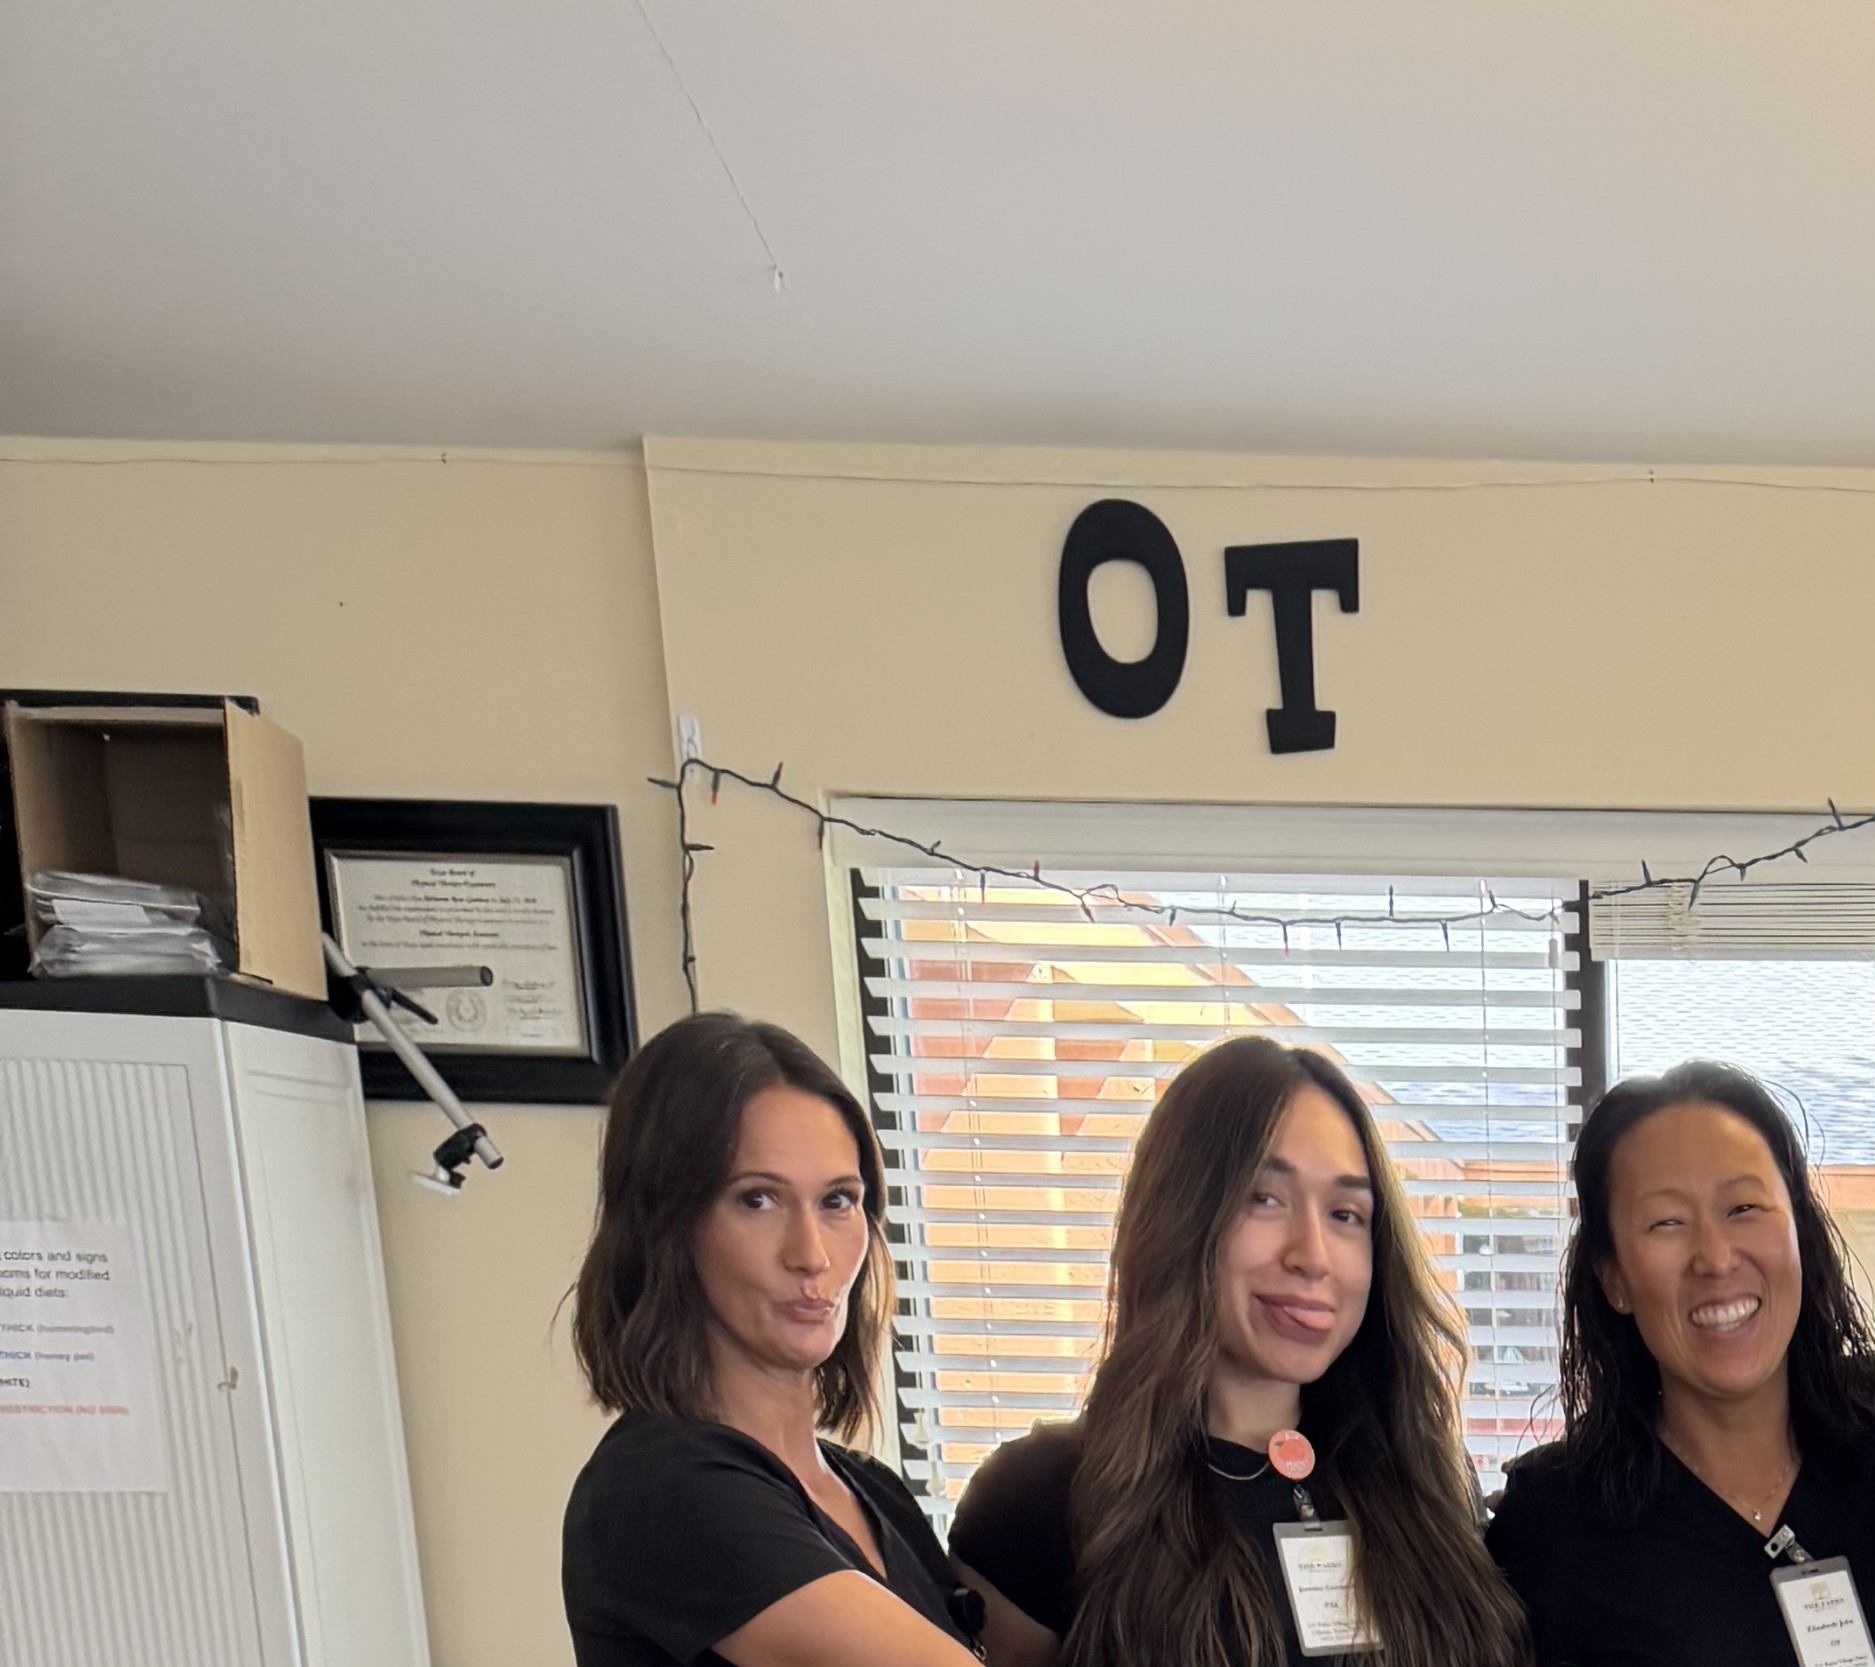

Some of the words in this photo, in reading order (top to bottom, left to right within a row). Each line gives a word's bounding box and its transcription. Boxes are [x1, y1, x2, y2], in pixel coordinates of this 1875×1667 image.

[1058, 497, 1360, 756] OT
[4, 1250, 43, 1262] colors
[47, 1250, 71, 1262] and
[75, 1252, 108, 1265] signs
[34, 1268, 51, 1280] for
[55, 1269, 110, 1281] modified
[0, 1377, 30, 1389] HITE)
